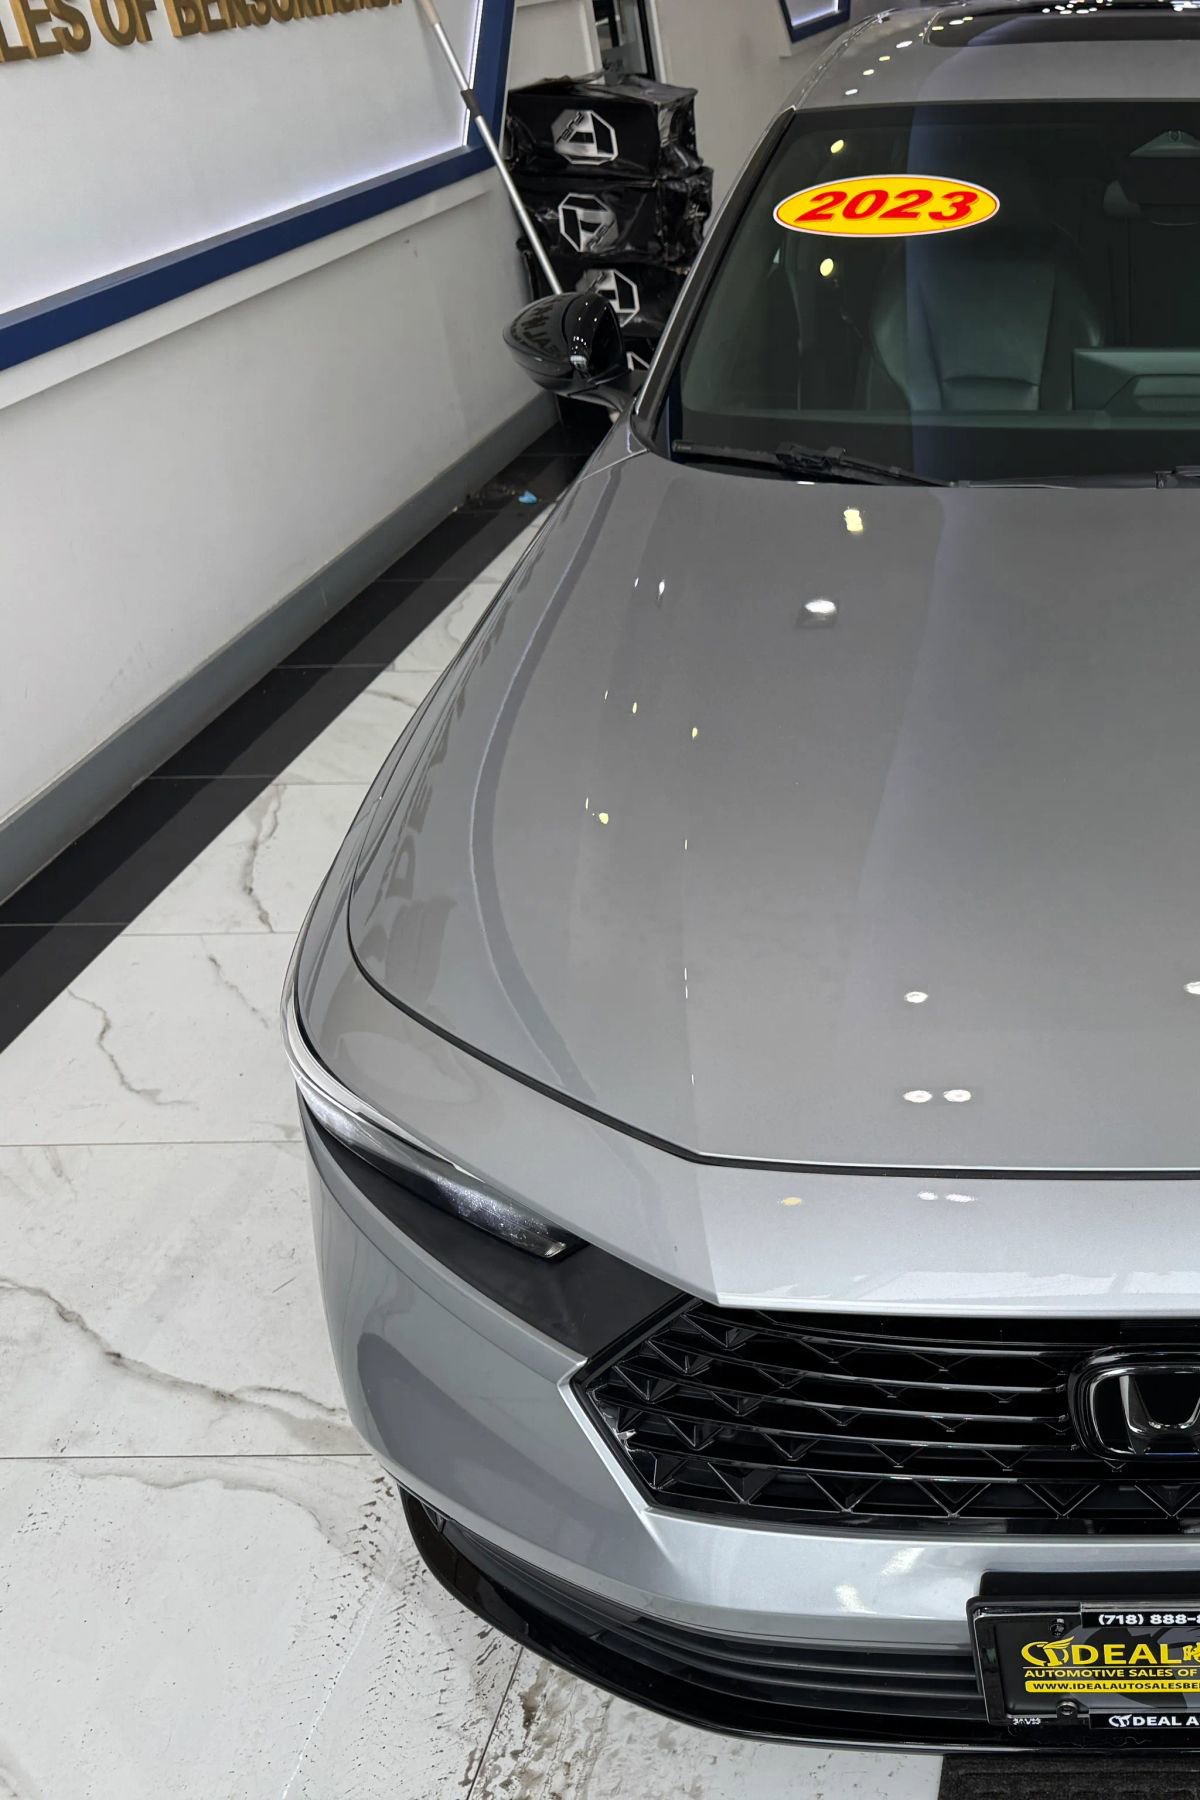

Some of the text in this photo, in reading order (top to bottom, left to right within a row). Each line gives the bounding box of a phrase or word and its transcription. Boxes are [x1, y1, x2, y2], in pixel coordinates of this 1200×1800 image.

[794, 189, 979, 223] 2023
[1098, 1614, 1144, 1625] (718)
[1024, 1669, 1125, 1678] AUTOMOTIVE
[1128, 1668, 1173, 1677] SALES
[1177, 1668, 1198, 1677] OF
